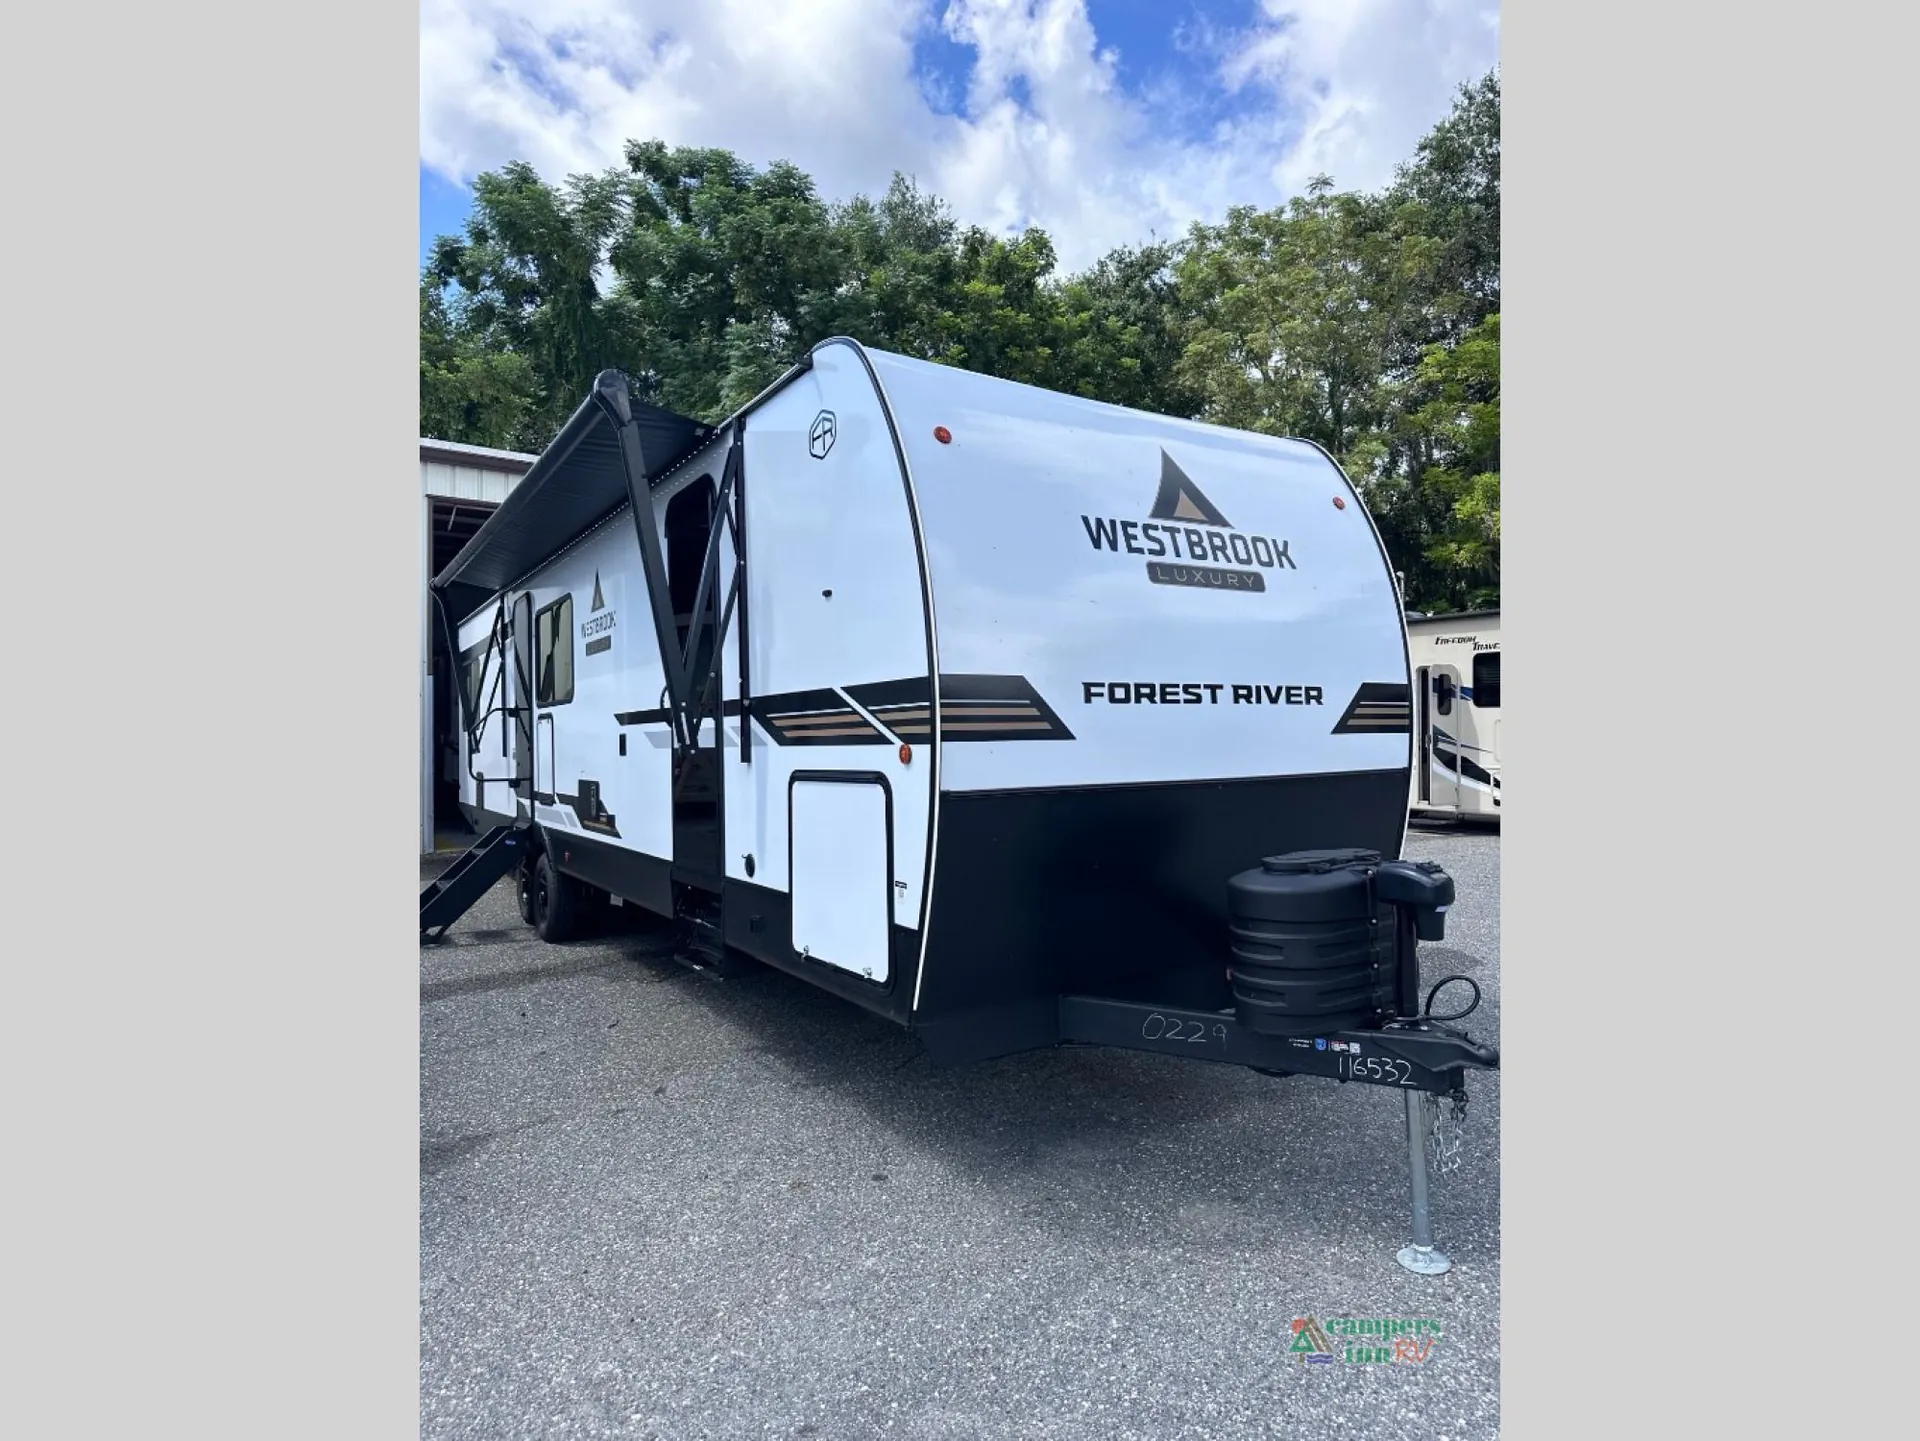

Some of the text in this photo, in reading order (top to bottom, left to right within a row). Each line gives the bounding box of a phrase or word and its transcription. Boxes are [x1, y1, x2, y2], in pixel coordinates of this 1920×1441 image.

[1081, 514, 1297, 570] WESTBROOK
[1156, 566, 1255, 588] LUXURY
[1081, 681, 1324, 706] FOREST RIVER
[1142, 1011, 1228, 1052] 0229
[1338, 1056, 1417, 1085] 116532
